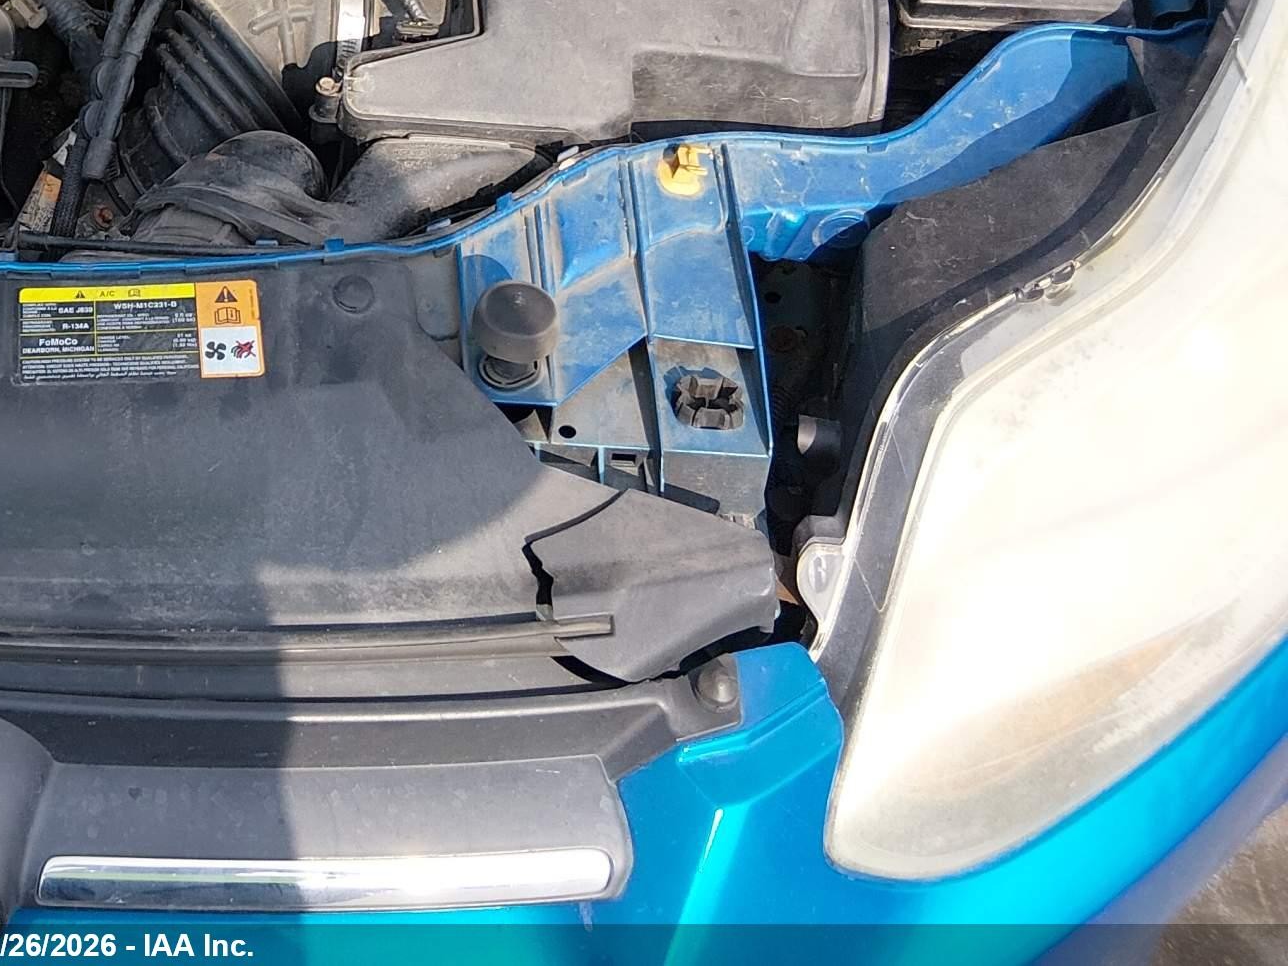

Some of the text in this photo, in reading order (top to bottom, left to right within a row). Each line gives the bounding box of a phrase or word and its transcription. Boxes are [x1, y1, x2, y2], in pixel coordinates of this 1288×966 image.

[99, 290, 115, 298] A/C
[39, 337, 78, 347] FoMoCo
[62, 345, 95, 353] MICHIGAN
